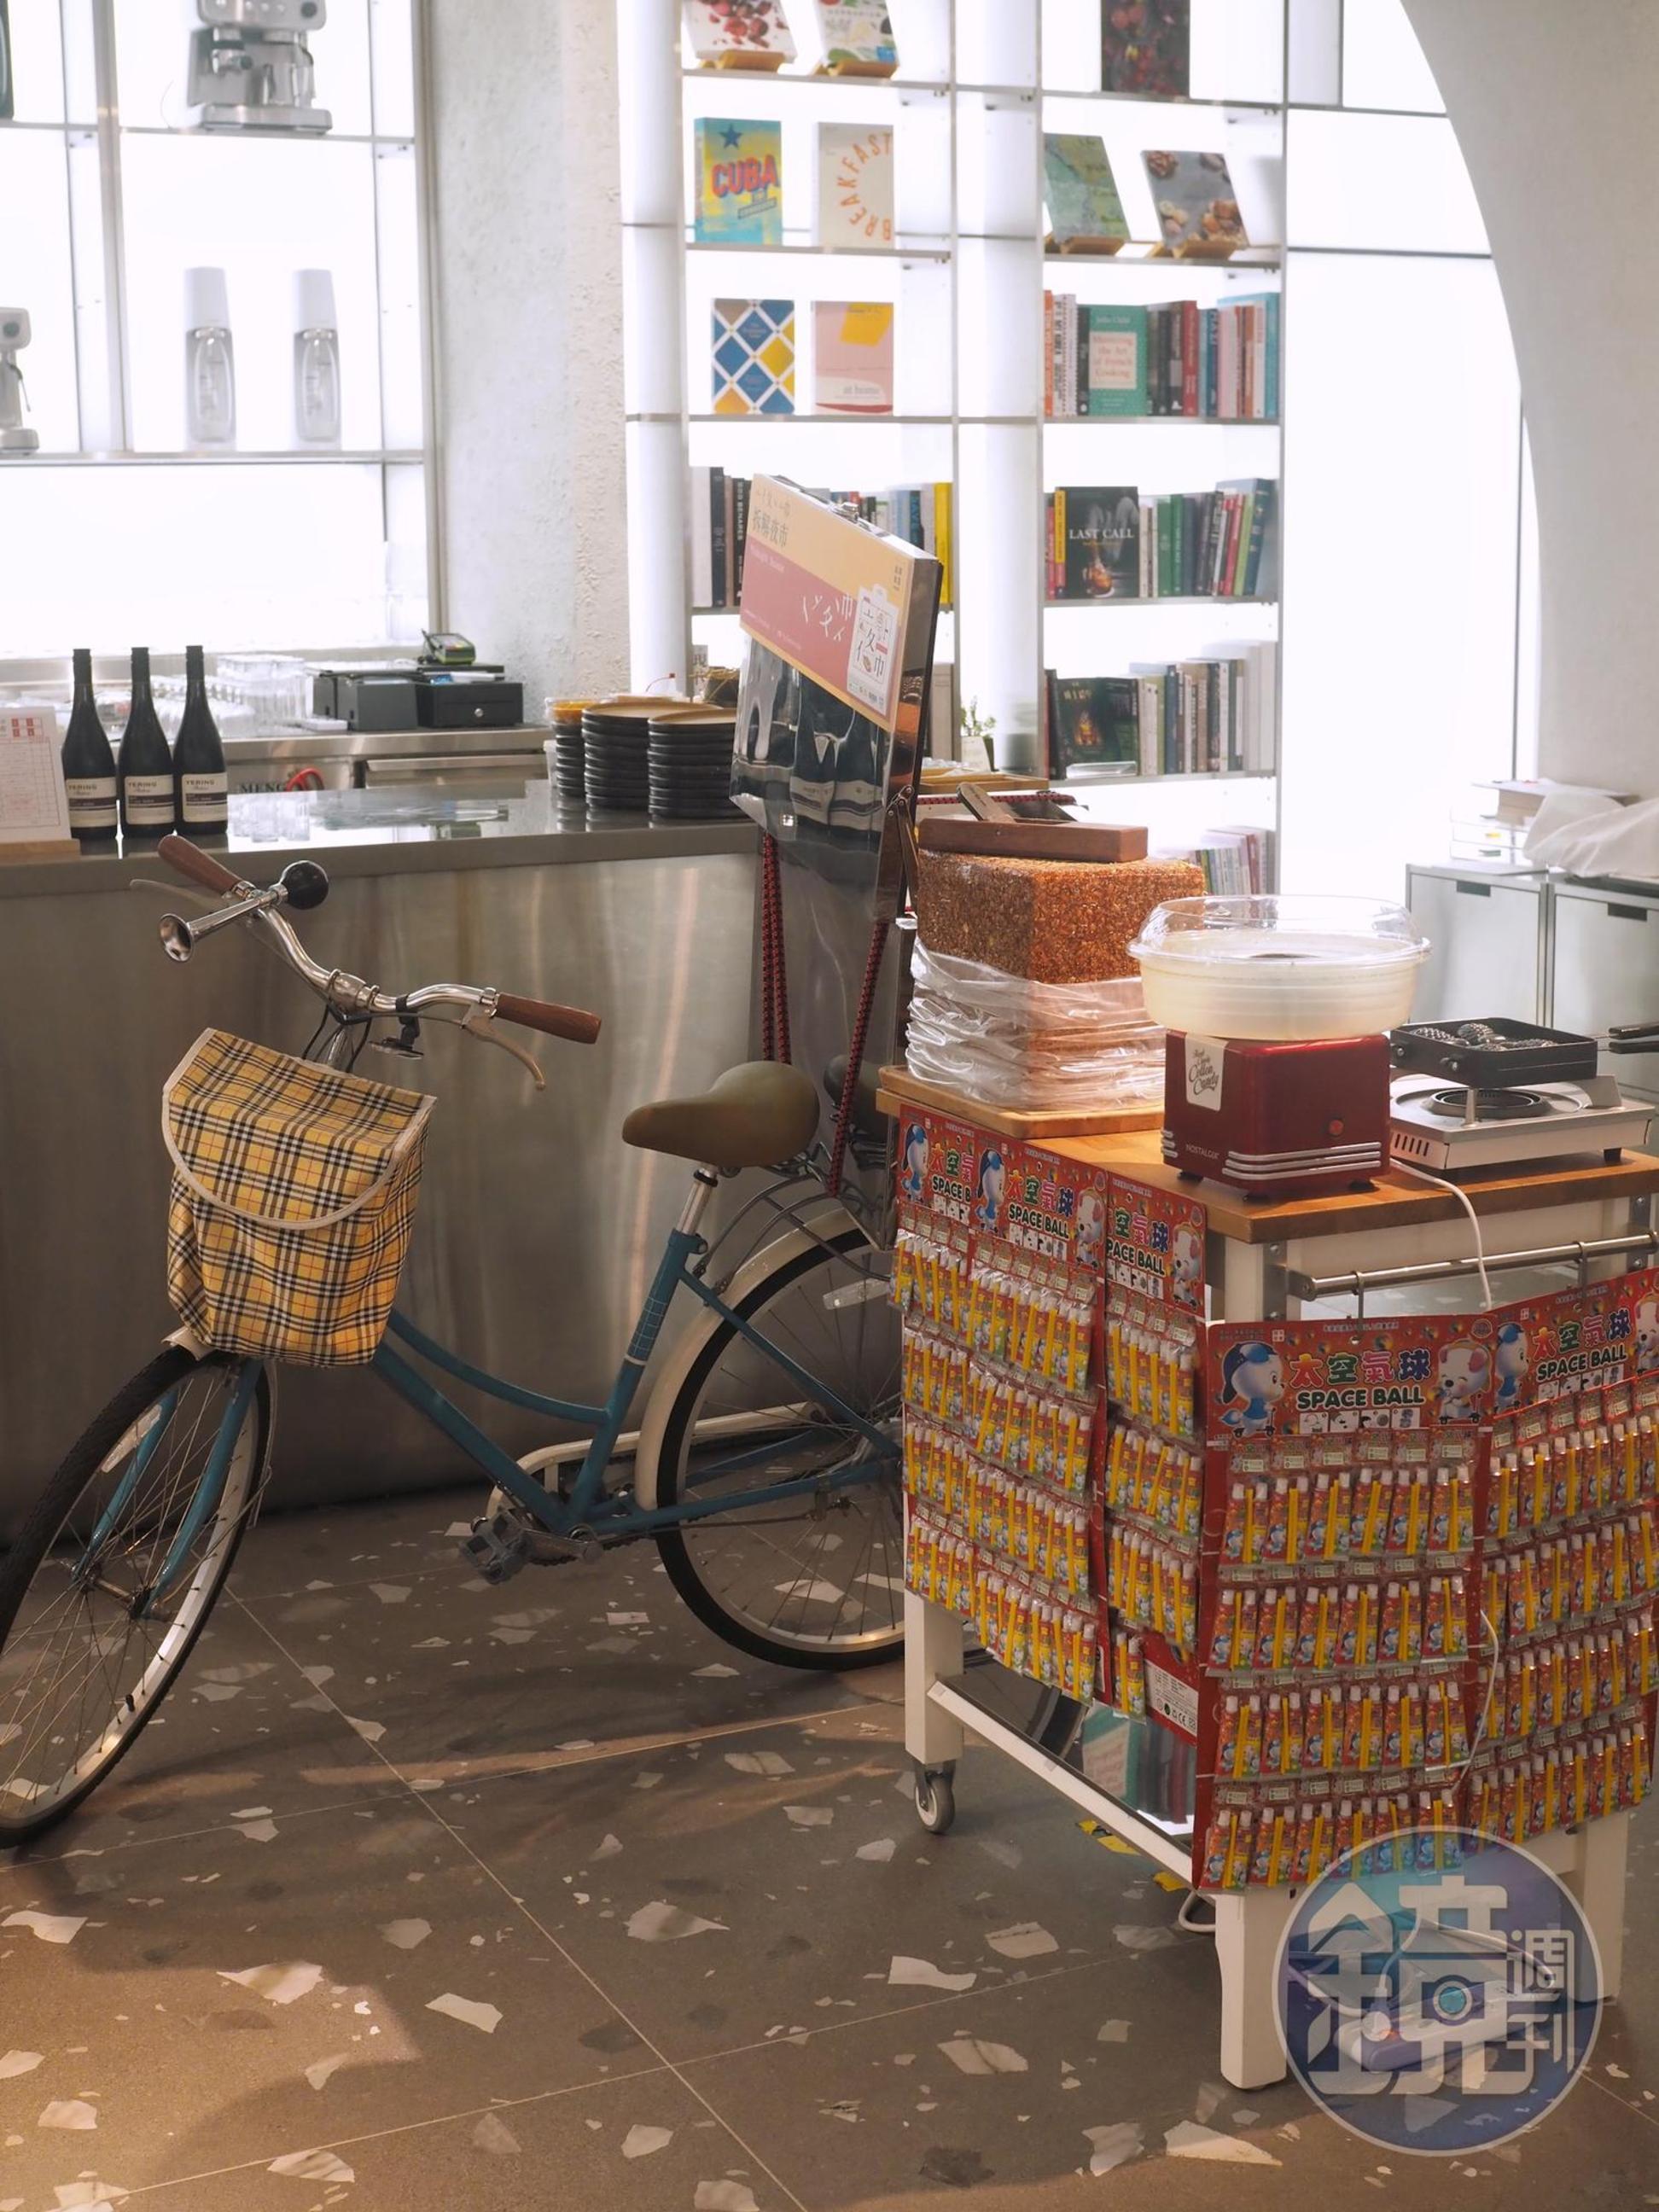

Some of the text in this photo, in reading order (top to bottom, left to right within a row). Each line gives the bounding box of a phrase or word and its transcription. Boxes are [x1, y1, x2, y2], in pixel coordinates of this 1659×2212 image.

[712, 154, 779, 198] CUBA
[837, 132, 892, 241] BREAKFAST
[1069, 527, 1134, 539] LAST CALL
[933, 1175, 963, 1200] SPACE
[1009, 1203, 1069, 1239] SPACE BALL
[1110, 1207, 1169, 1254] 空氣球
[1107, 1238, 1166, 1277] PACE BALL
[1533, 1307, 1633, 1361] 太空氣球
[1289, 1348, 1431, 1388] 太空氣球
[1537, 1344, 1627, 1381] SPACE BALL
[1297, 1386, 1425, 1410] SPACE BALL
